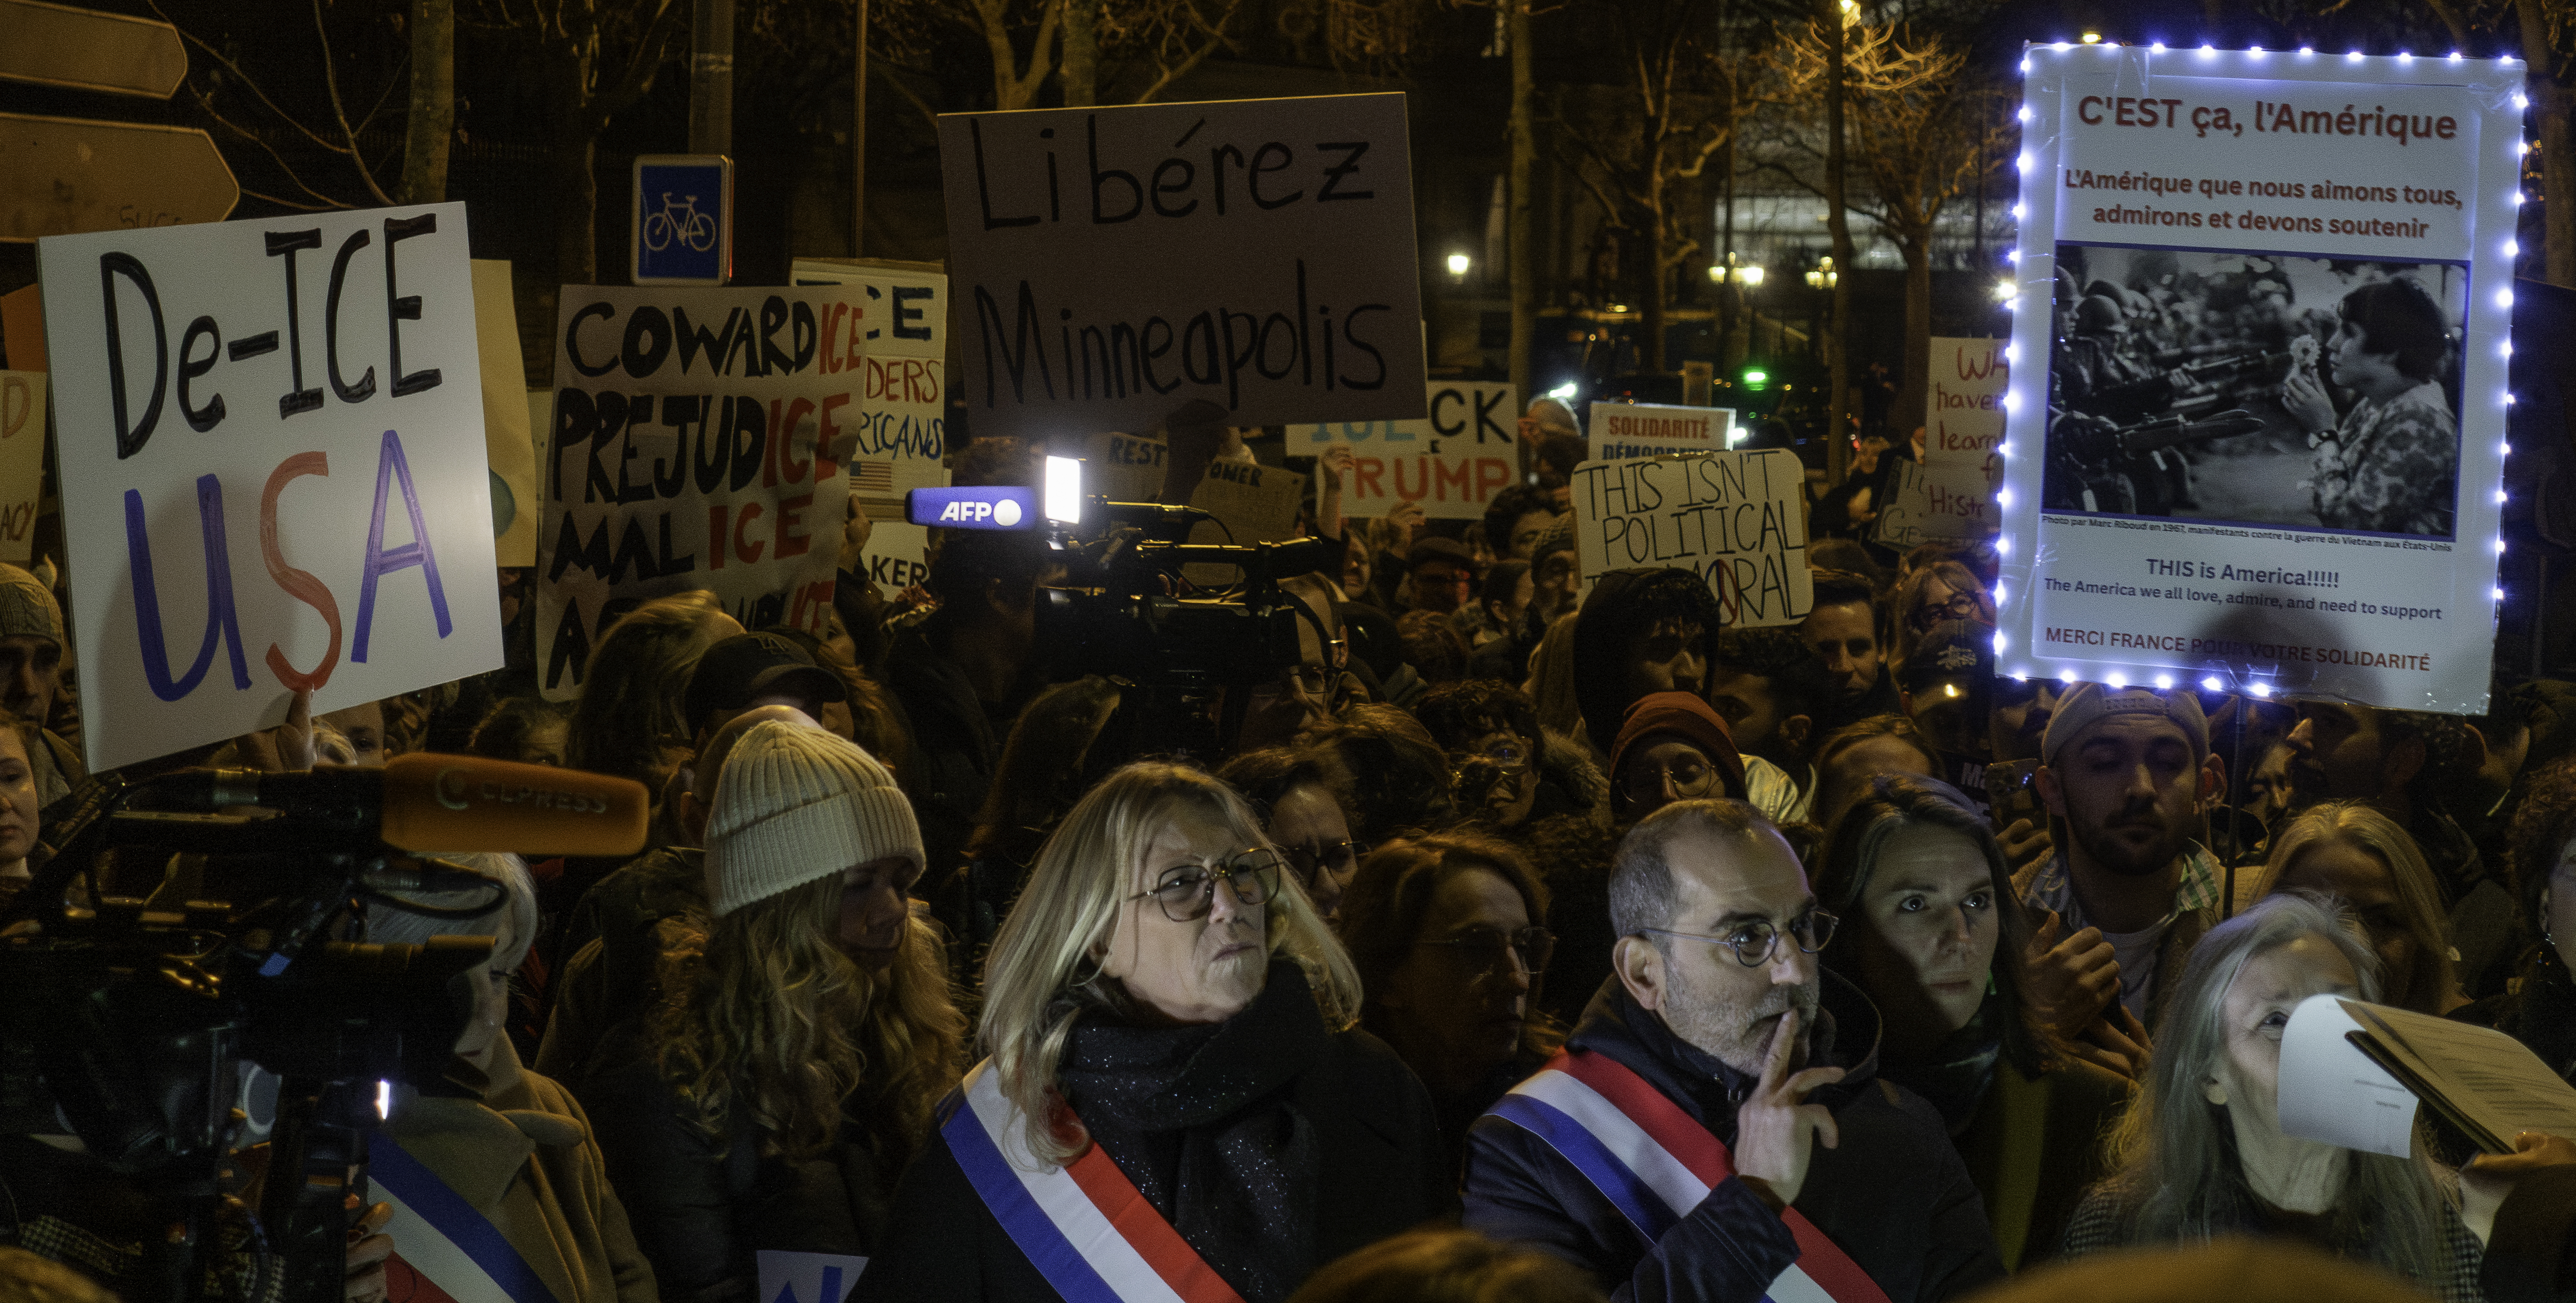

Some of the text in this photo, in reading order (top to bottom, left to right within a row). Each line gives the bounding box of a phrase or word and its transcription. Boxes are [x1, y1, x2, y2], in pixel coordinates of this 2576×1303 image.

[2078, 95, 2457, 146] C'EST ça, l'Amérique
[969, 113, 1374, 231] Libérez
[2066, 169, 2462, 210] L'Amérique que nous aimons tous,
[2093, 204, 2429, 238] admirons et devons soutenir
[100, 213, 442, 460] De-ICE
[566, 295, 863, 379] COWARDICE
[975, 258, 1392, 411] Minneapolis
[553, 387, 850, 506] PREJUDICE
[1609, 416, 1710, 439] SOLIDARITÉ
[1354, 456, 1511, 503] RUMP
[1574, 450, 1780, 521] THIS ISN'T
[939, 501, 992, 522] AFP
[1603, 500, 1806, 566] POLITICAL
[2043, 516, 2069, 525] Photo
[2071, 518, 2087, 527] par
[2089, 519, 2111, 528] Marc
[2115, 520, 2147, 531] Riboud
[2188, 525, 2249, 538] manifestants
[2251, 531, 2282, 540] contre
[2284, 532, 2293, 541] la
[2295, 534, 2325, 544] guerre
[2328, 536, 2340, 544] du
[2342, 537, 2382, 547] Vietnam
[124, 430, 453, 702] USA
[2147, 558, 2340, 588] THIS is America!!!!!
[2044, 577, 2442, 620] The America we all love, admire, and need to support
[2046, 627, 2430, 672] MERCI FRANCE POUR VOTRE SOLIDARITÉ
